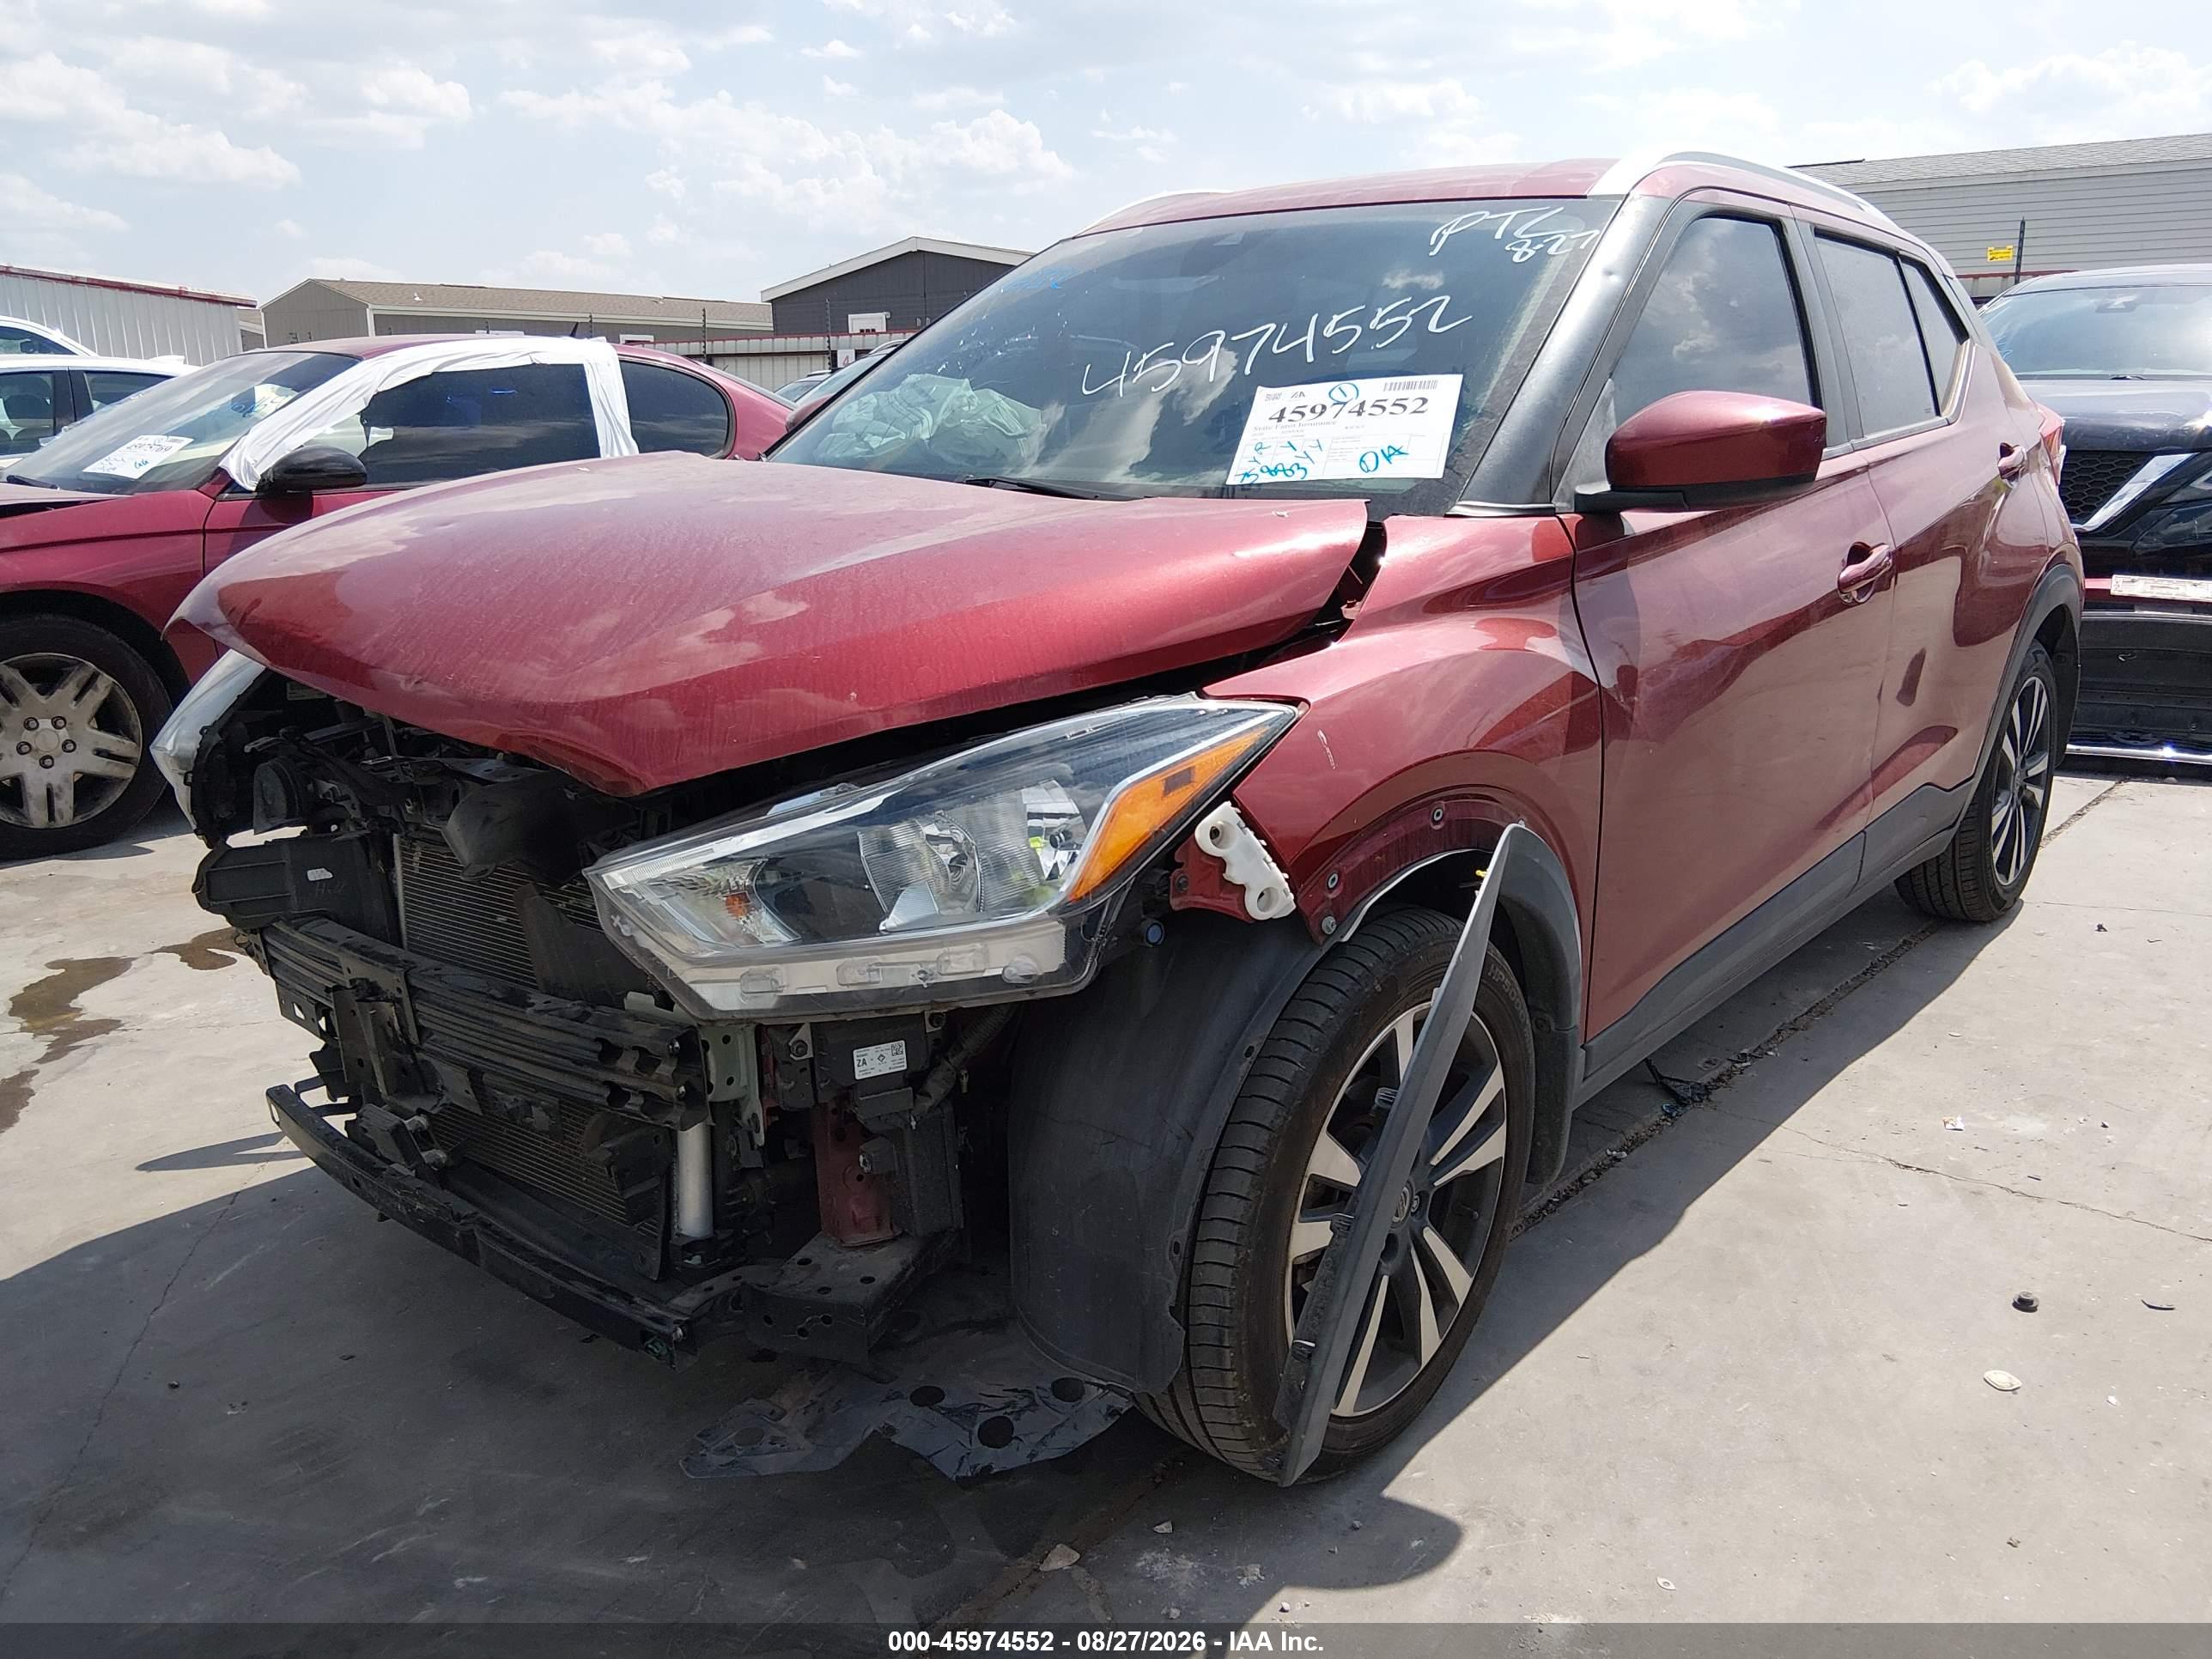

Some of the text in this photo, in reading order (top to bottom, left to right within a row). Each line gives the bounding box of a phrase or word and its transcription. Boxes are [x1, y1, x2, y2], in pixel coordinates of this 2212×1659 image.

[1080, 295, 1474, 398] 45974552
[1267, 397, 1429, 423] 45974552
[856, 1058, 867, 1067] ZA
